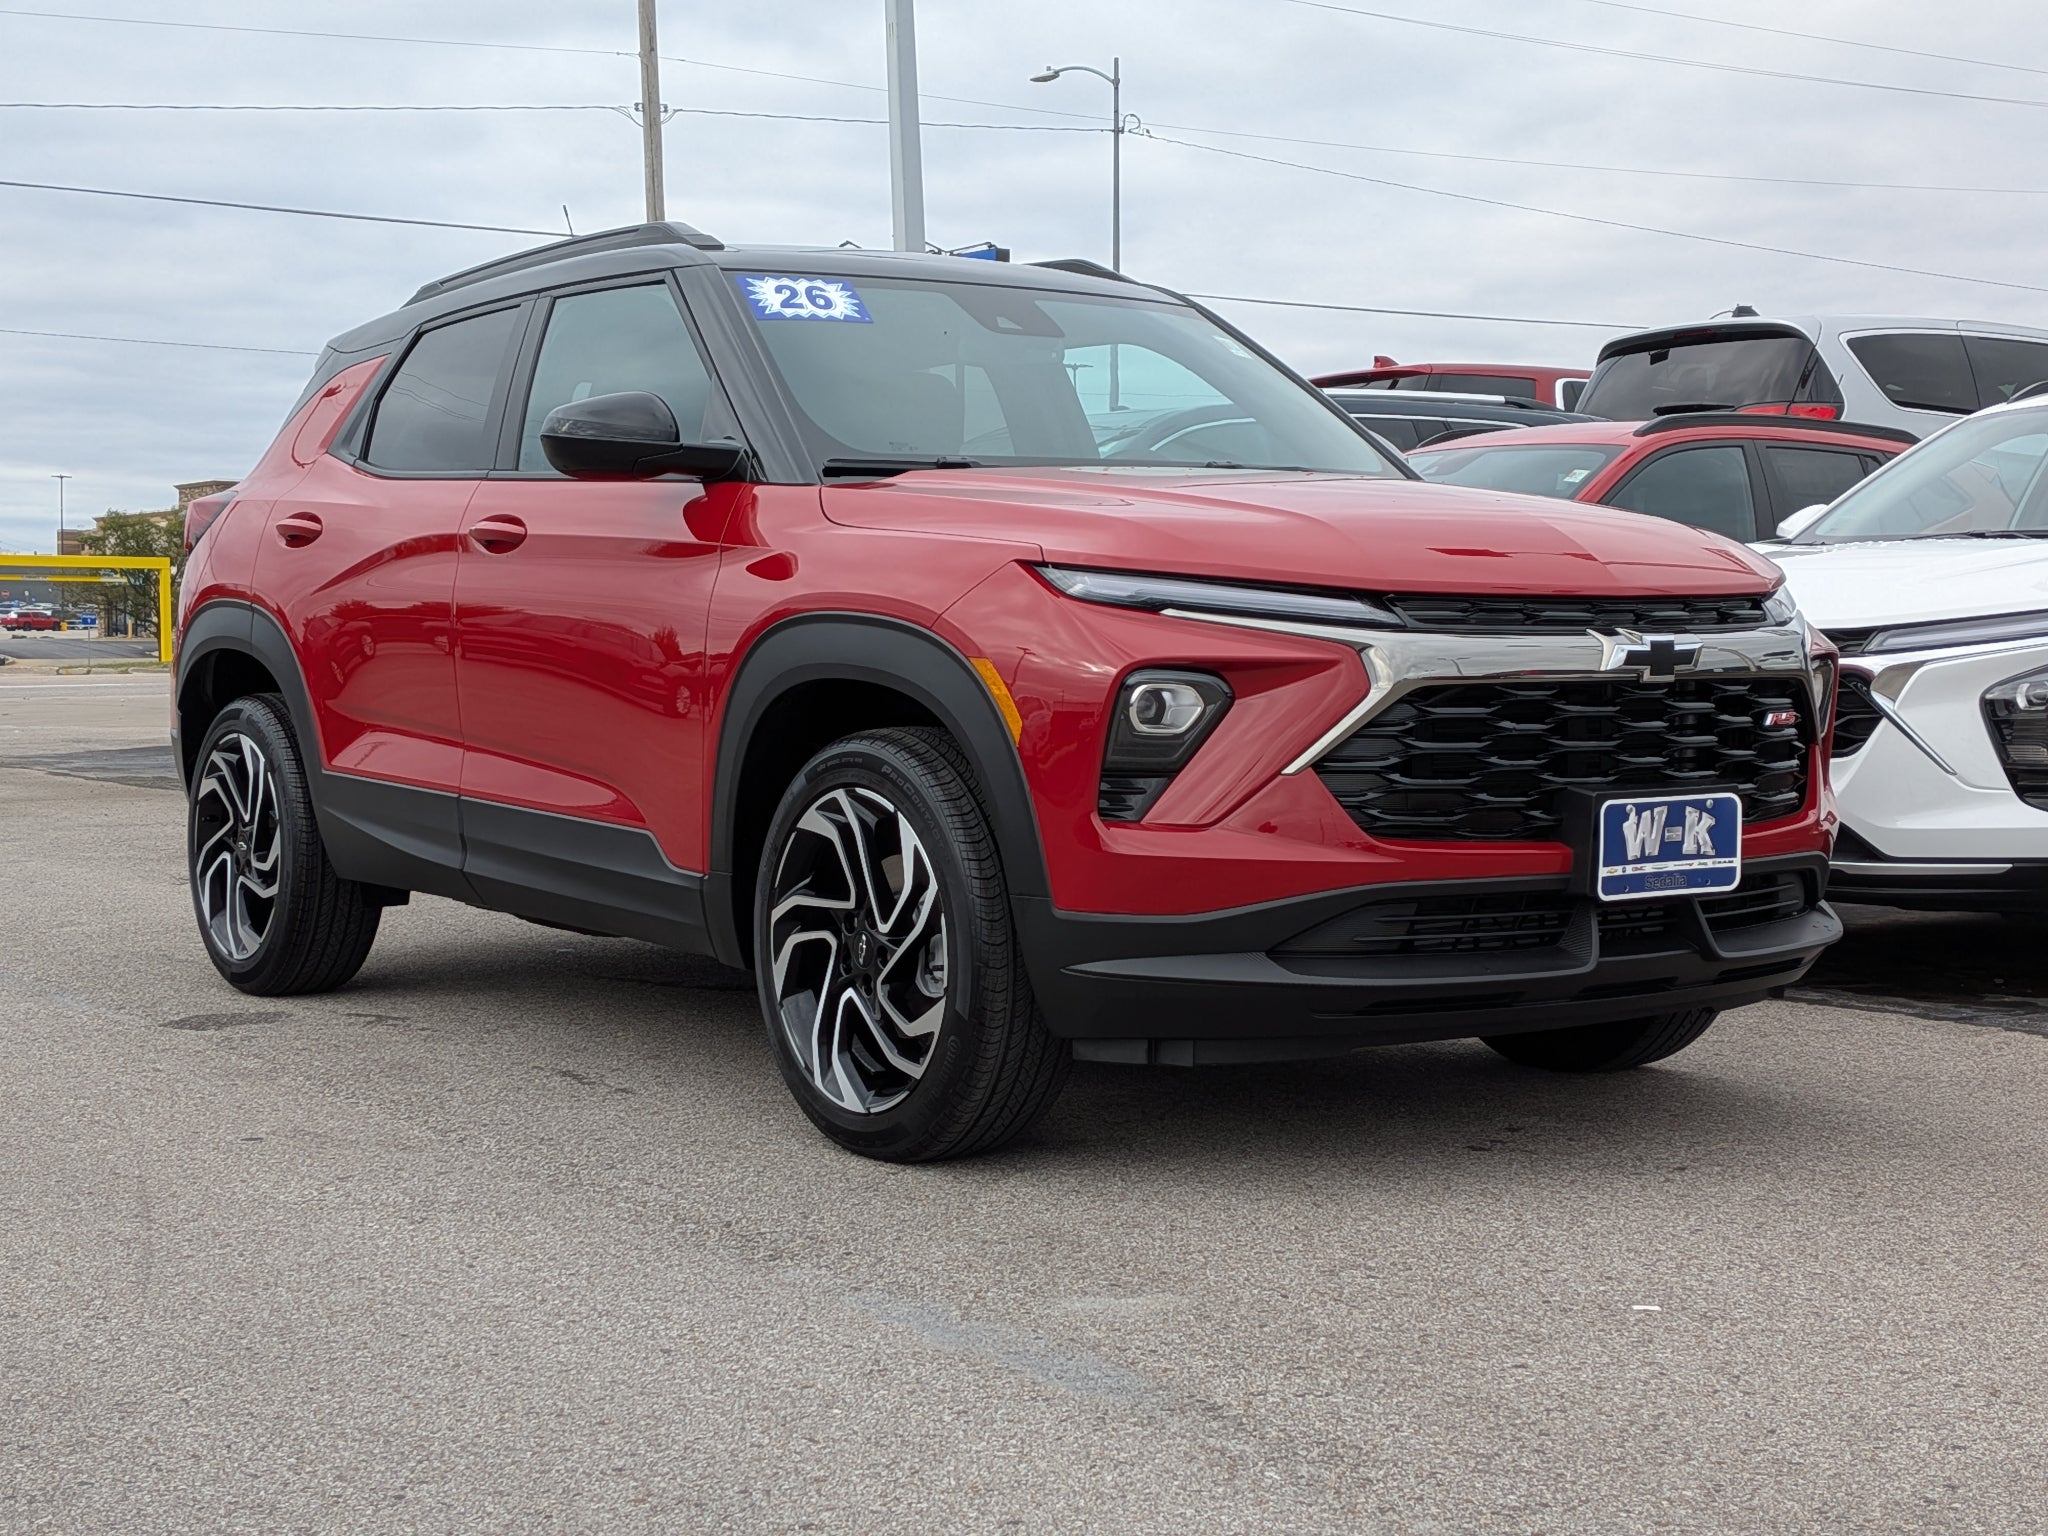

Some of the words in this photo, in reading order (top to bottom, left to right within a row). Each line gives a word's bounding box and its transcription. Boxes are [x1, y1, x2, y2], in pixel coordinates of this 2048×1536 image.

[774, 284, 835, 311] 26
[1766, 711, 1796, 726] RS
[1622, 804, 1716, 861] W-K
[1644, 873, 1688, 890] Sedalia
